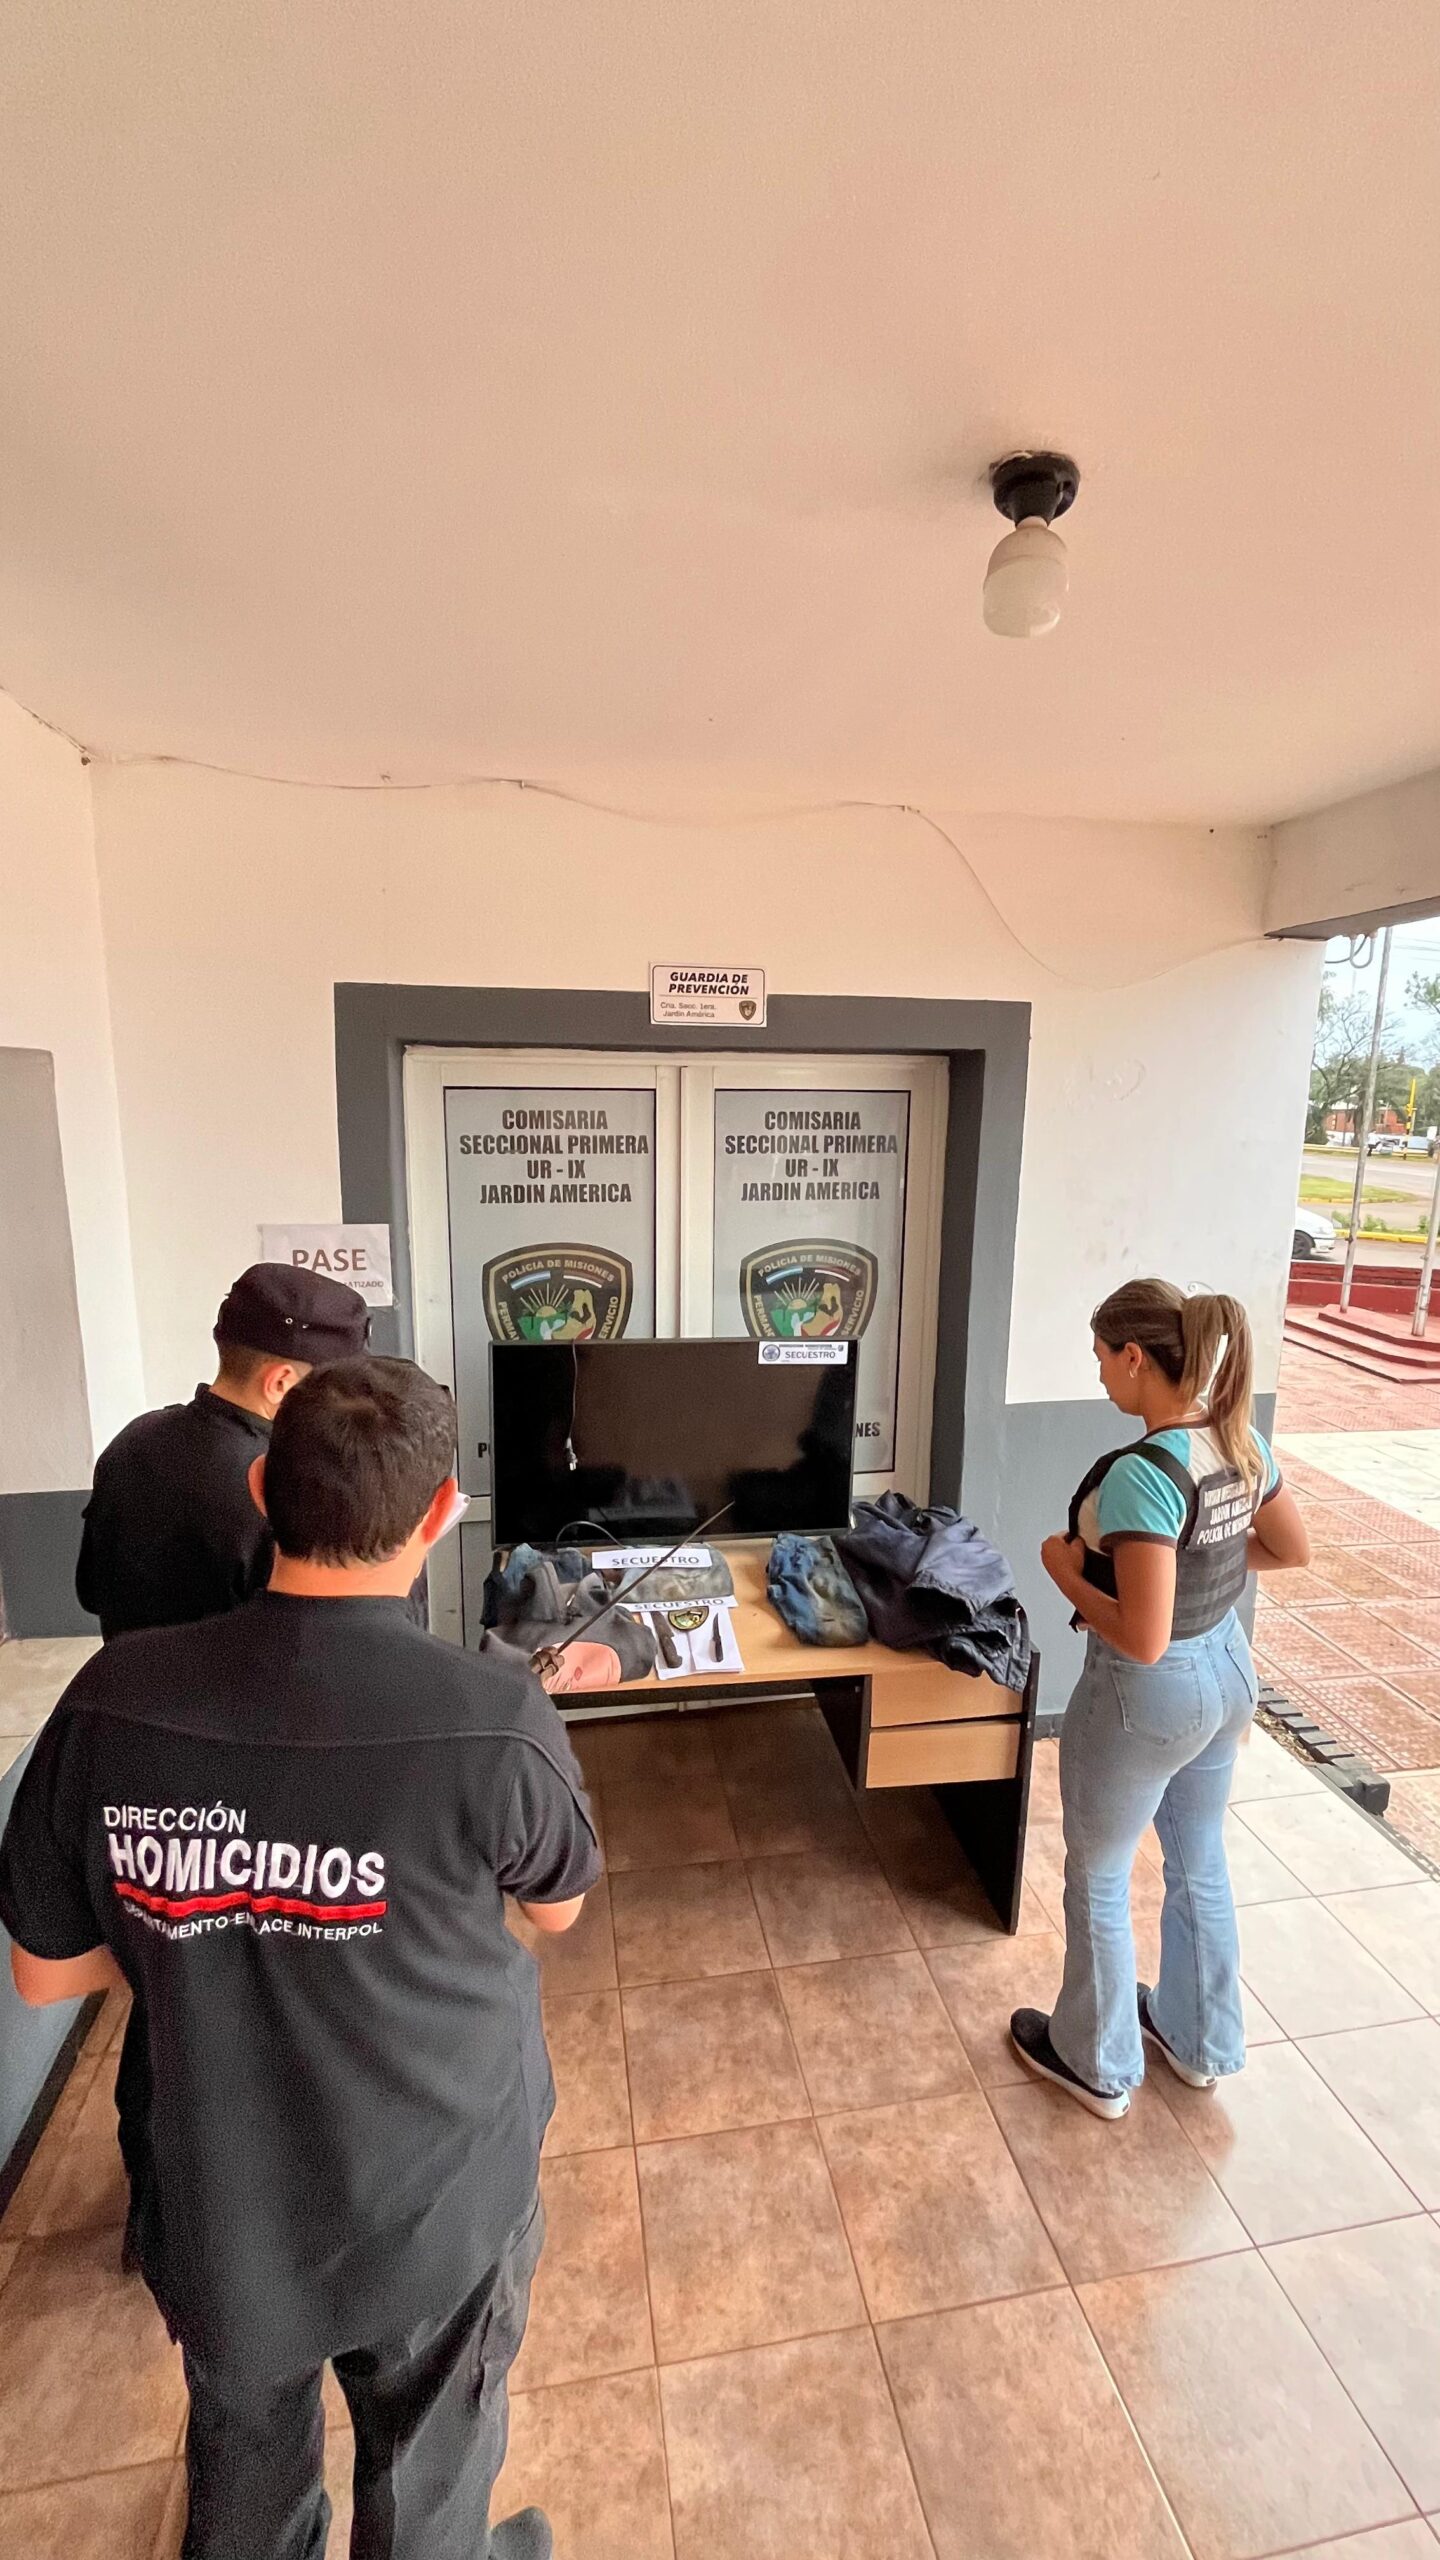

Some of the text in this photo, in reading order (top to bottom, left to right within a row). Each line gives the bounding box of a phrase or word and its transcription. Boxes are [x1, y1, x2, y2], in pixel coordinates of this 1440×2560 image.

[670, 971, 748, 984] GUARDIA DE
[668, 982, 749, 995] PREVENCIÓN
[502, 1109, 608, 1130] COMISARIA
[765, 1111, 861, 1130] COMISARIA
[460, 1135, 649, 1154] SECCIONAL PRIMERA
[725, 1135, 898, 1154] SECCIONAL PRIMERA
[527, 1160, 552, 1179] UR
[568, 1160, 586, 1179] IX
[785, 1159, 808, 1177] UR
[823, 1159, 839, 1177] IX
[480, 1184, 632, 1204] JARDIN AMERICA
[741, 1181, 880, 1201] JARDIN AMERICA
[292, 1249, 367, 1272] PASE
[758, 1254, 861, 1277] POLICIA DE MISIONES
[502, 1259, 615, 1284] POLICIA DE MISIONES
[598, 1296, 619, 1339] ERVICIO
[785, 1351, 836, 1359] SECUESTRO
[103, 1800, 247, 1834] DIRECCIÓN
[108, 1833, 386, 1899] HOMICIDIOS
[298, 1922, 383, 1941] INTERPOL
